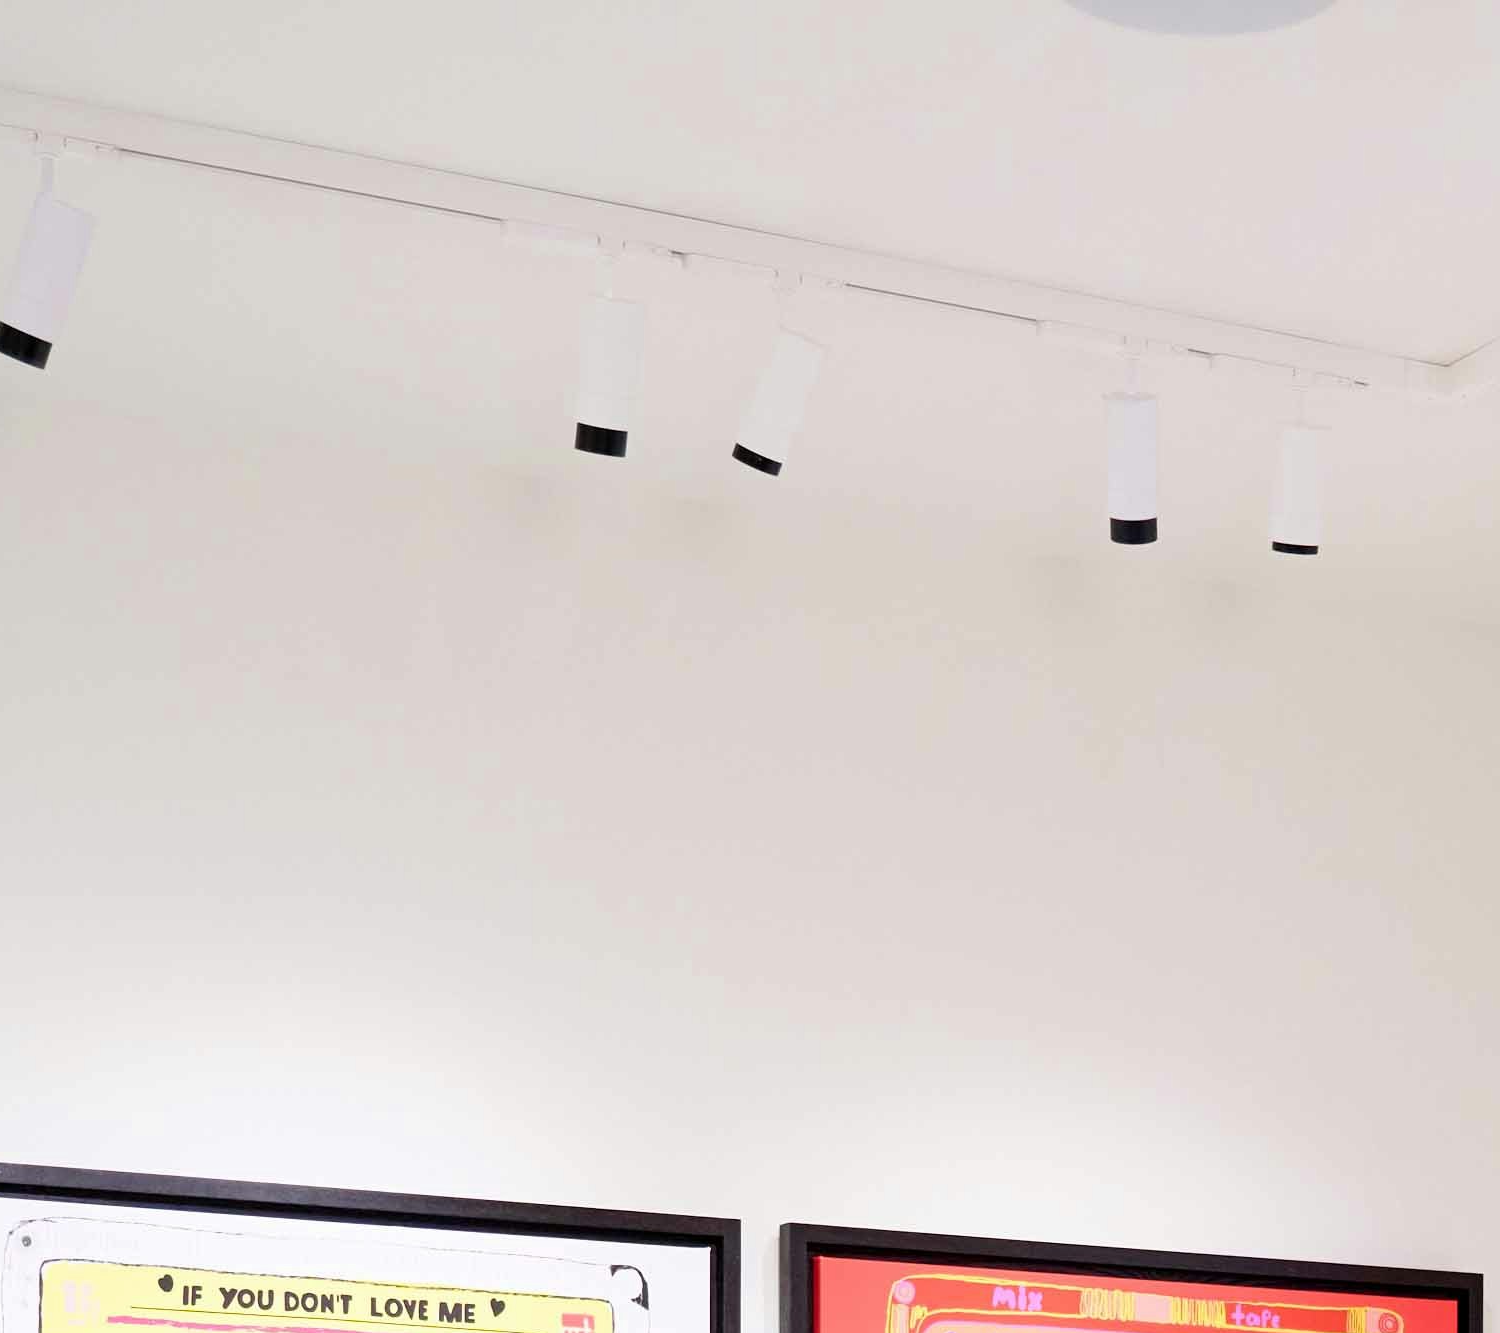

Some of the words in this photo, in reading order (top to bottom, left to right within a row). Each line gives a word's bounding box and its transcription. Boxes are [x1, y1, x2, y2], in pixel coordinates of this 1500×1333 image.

[182, 1285, 203, 1306] IF
[218, 1287, 275, 1311] YOU
[284, 1291, 353, 1315] DON'T
[370, 1297, 429, 1321] LOVE
[438, 1301, 476, 1324] ME
[991, 1284, 1044, 1313] mix
